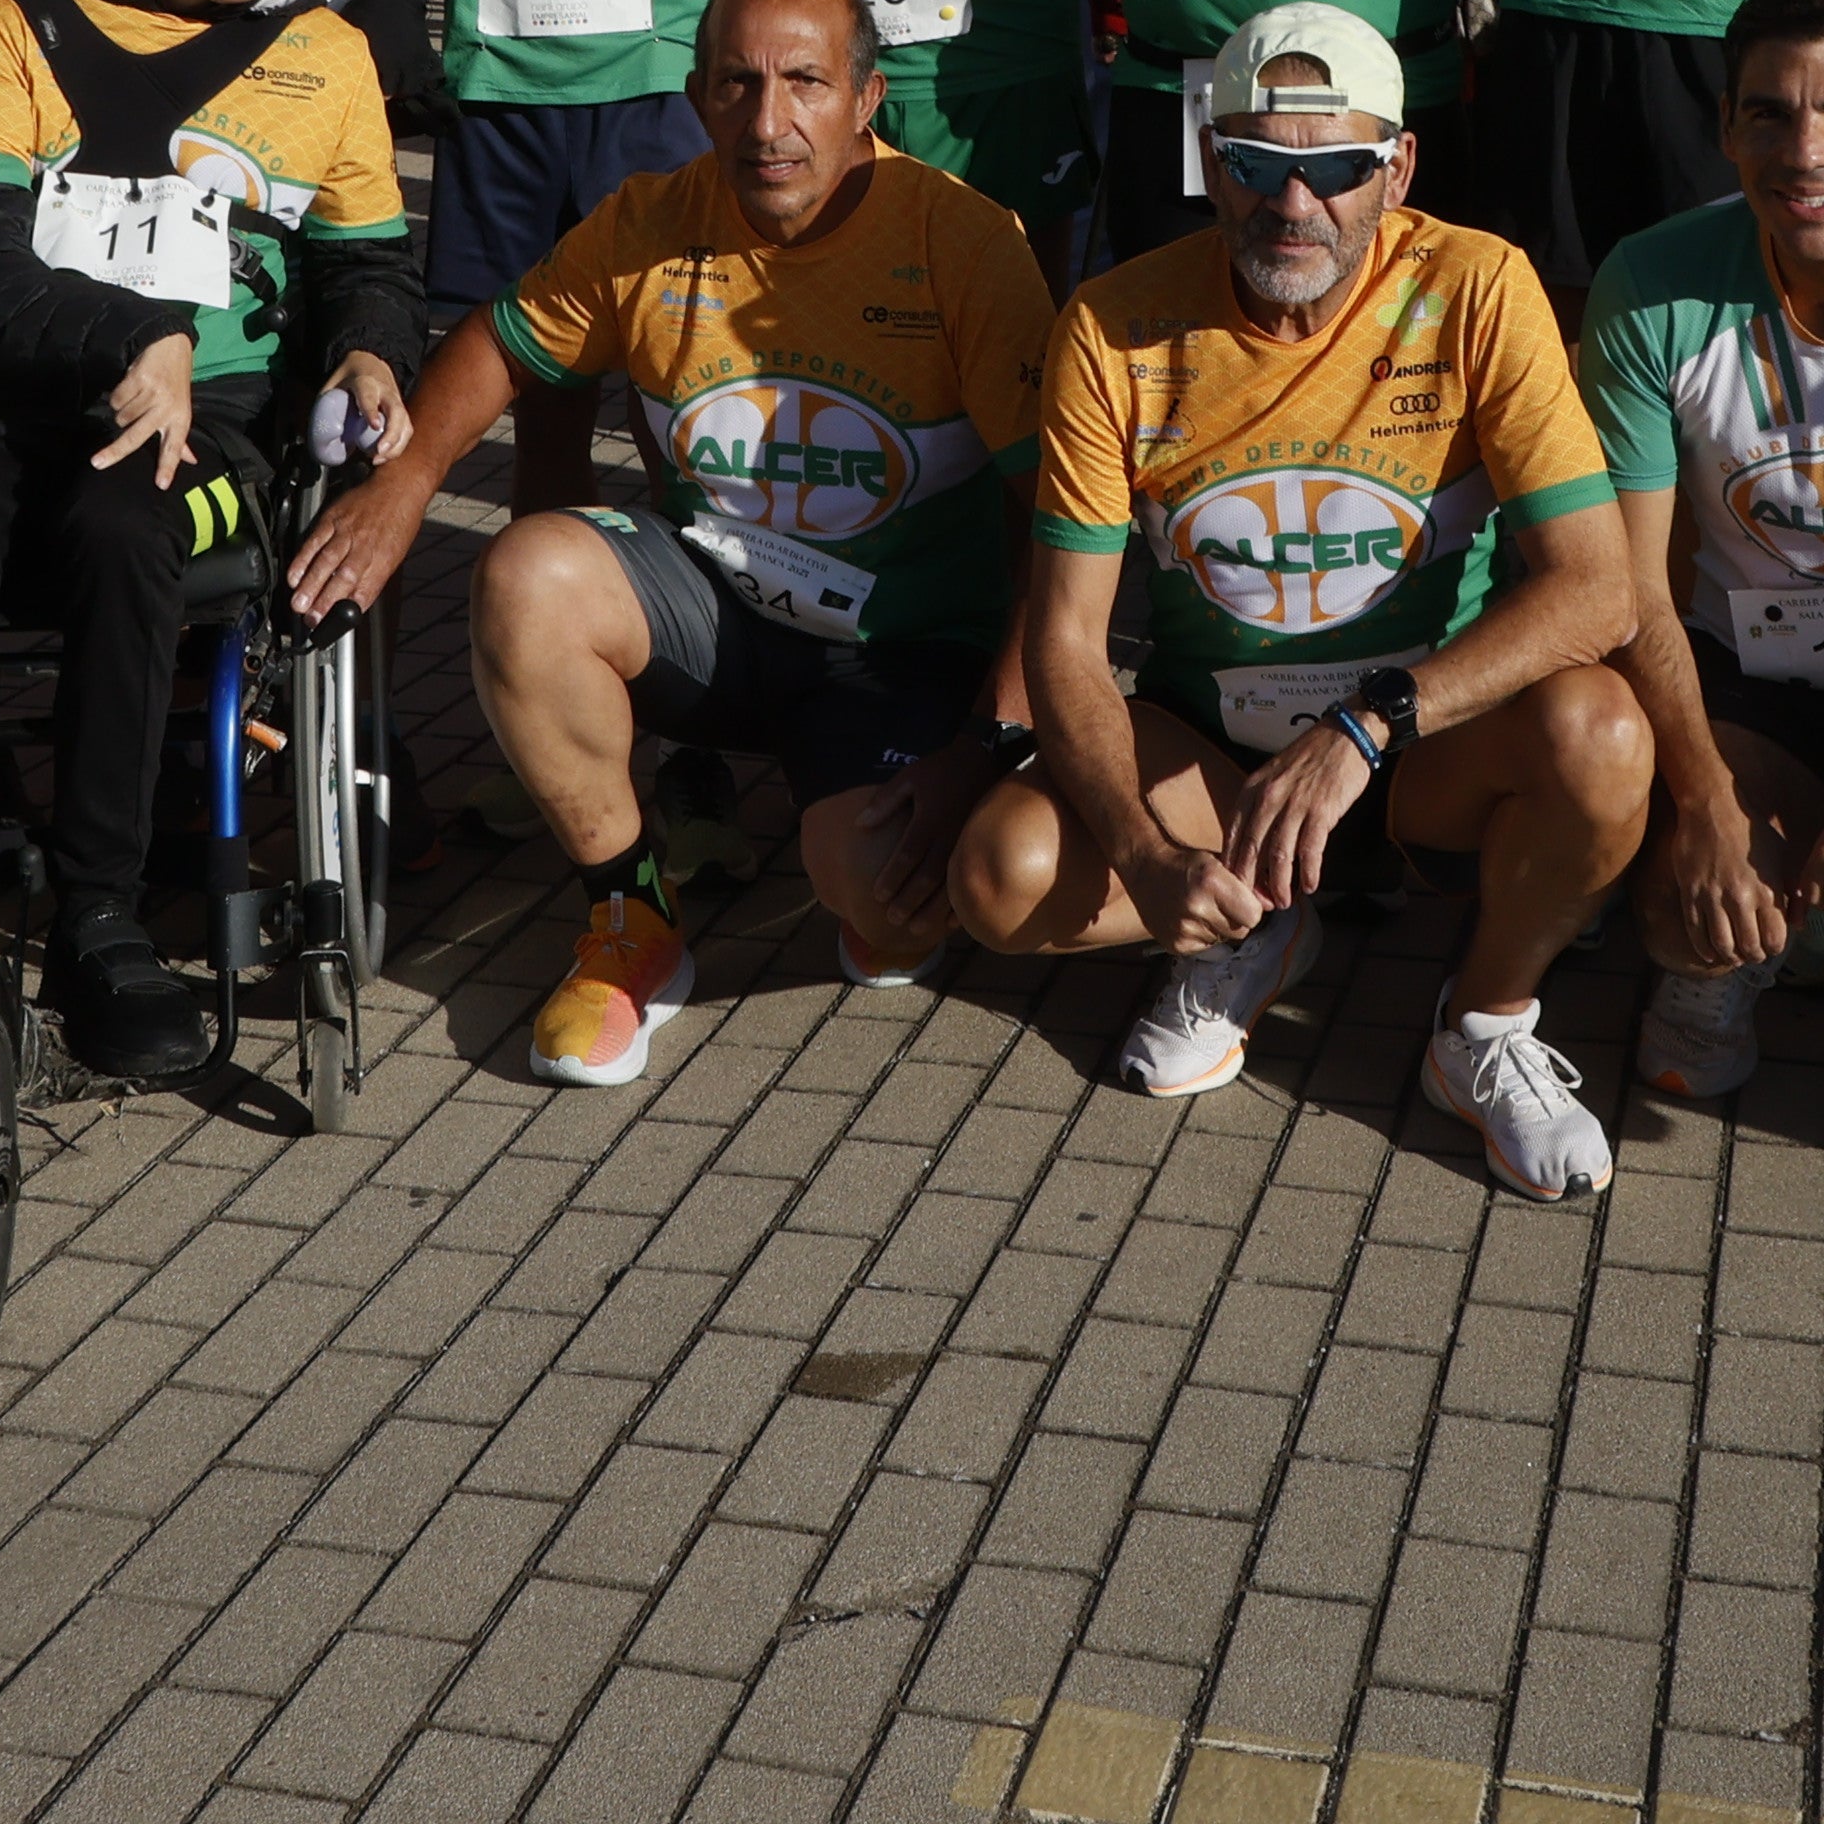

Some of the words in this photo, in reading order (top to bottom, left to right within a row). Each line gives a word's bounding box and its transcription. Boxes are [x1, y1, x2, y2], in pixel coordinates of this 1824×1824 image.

[267, 69, 325, 87] consulting
[193, 109, 284, 174] ORTIVO
[99, 215, 158, 261] 11
[889, 308, 941, 323] consultin
[669, 356, 734, 403] CLUB
[752, 350, 914, 419] DEPORTIVO
[1370, 418, 1464, 439] Helmántica
[687, 436, 887, 497] ALCER
[1162, 461, 1226, 505] CLUB
[1246, 440, 1428, 492] DEPORTIVO
[1719, 440, 1783, 477] CLUB
[1194, 527, 1406, 573] ALCER
[733, 571, 801, 619] 34
